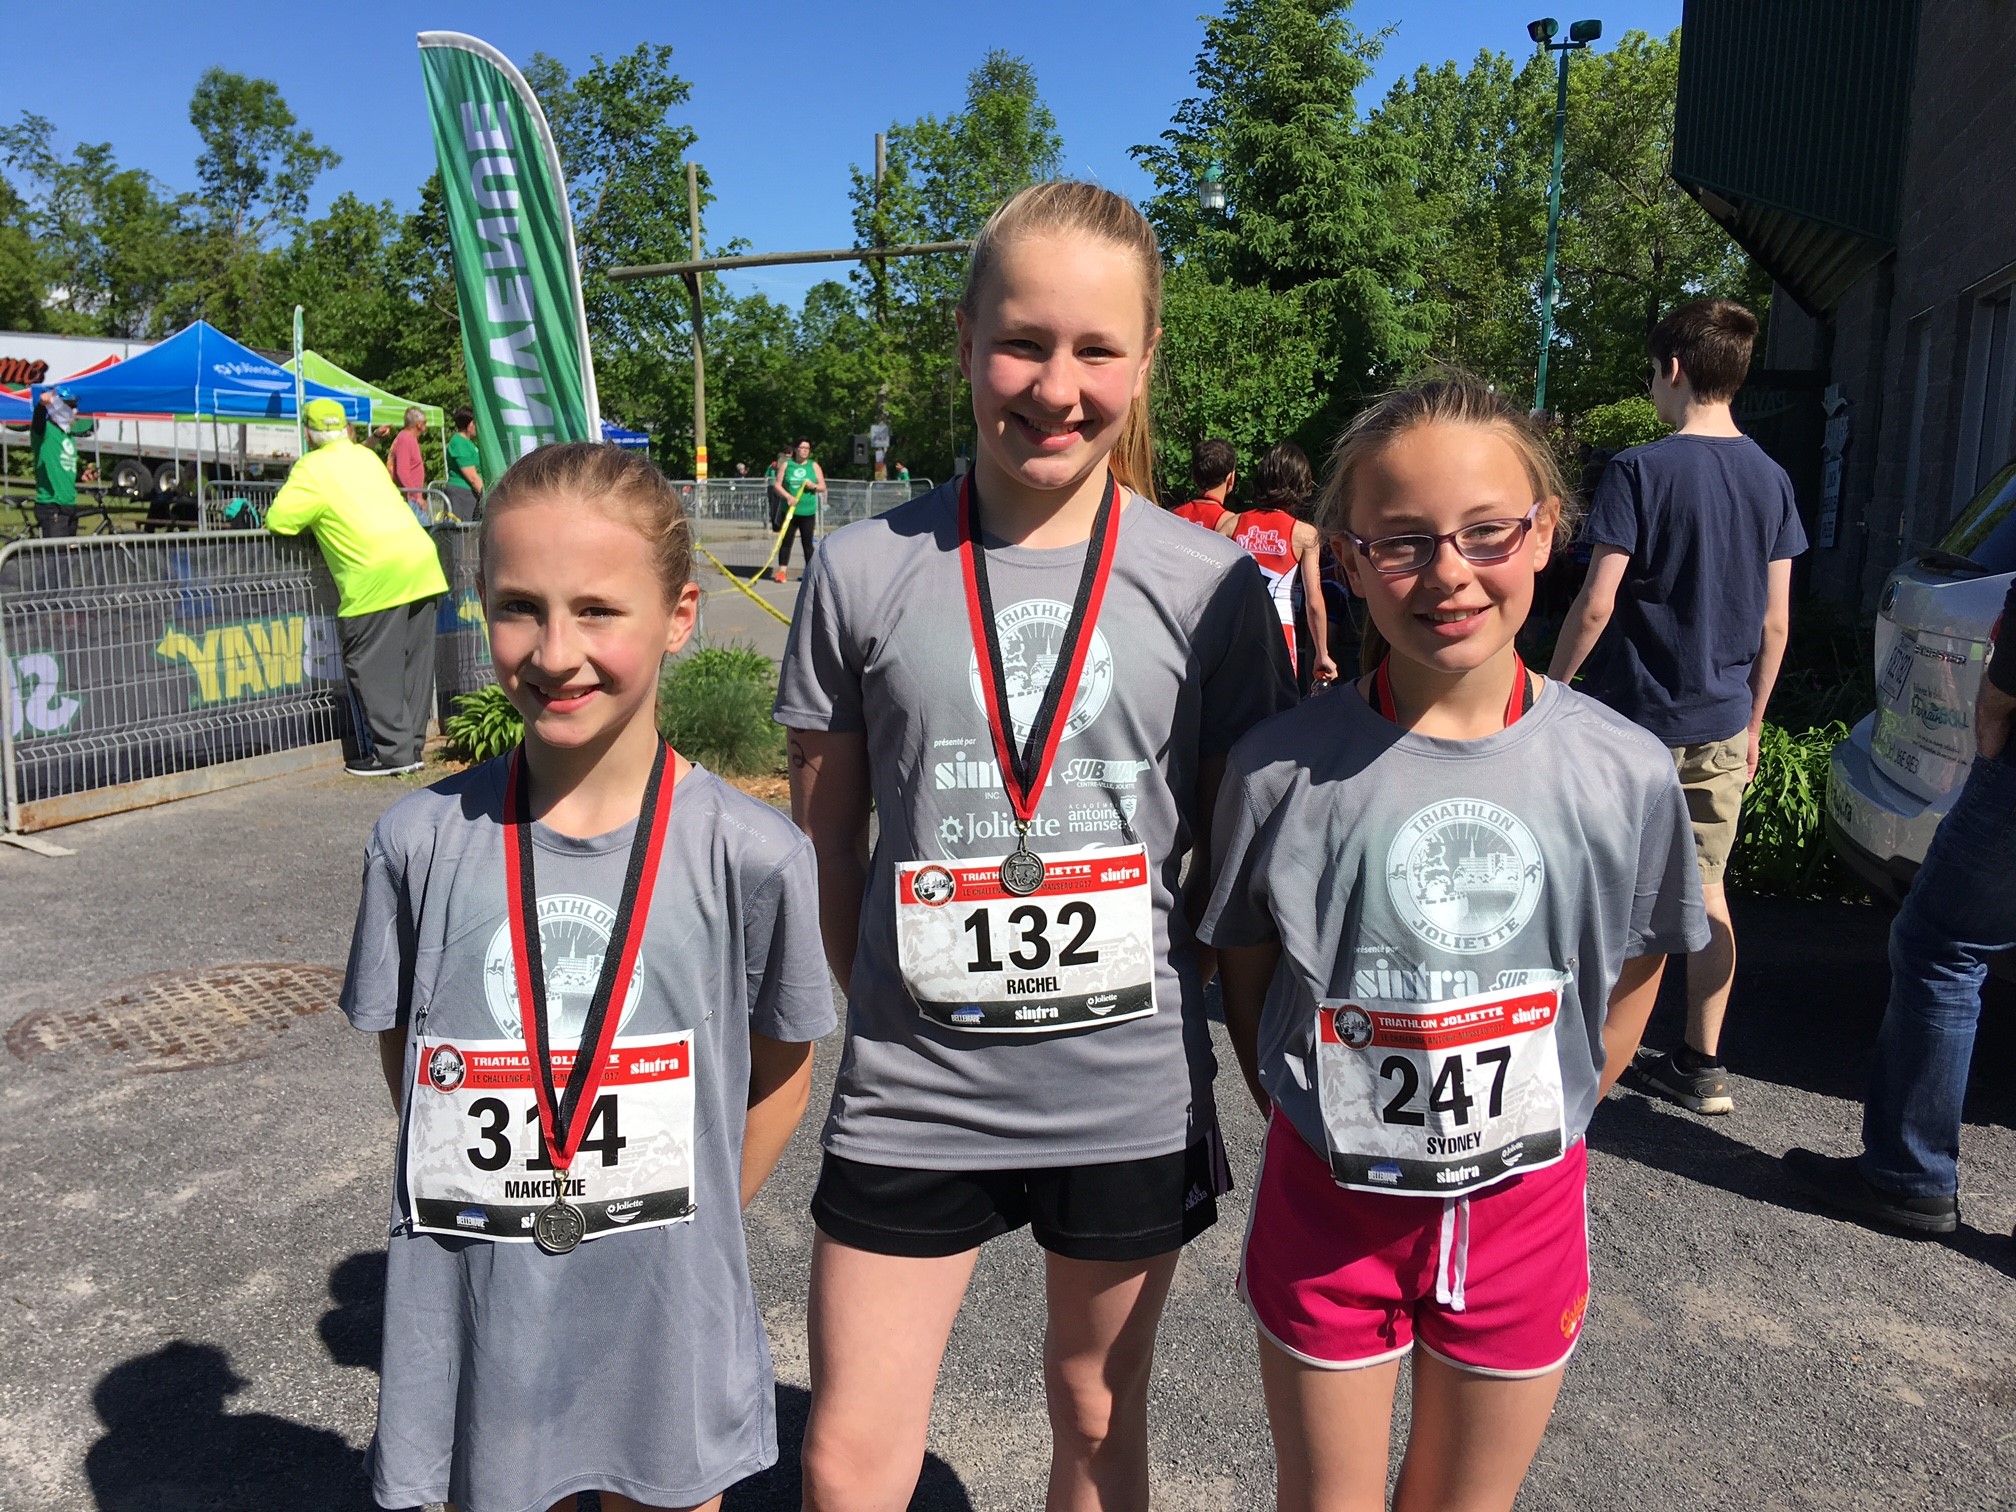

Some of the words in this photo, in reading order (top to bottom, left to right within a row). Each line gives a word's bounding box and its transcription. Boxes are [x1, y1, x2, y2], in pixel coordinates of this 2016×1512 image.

[964, 738, 977, 747] par
[1068, 808, 1121, 820] antoine
[1410, 803, 1515, 835] TRIATHLON
[1069, 819, 1123, 832] mansea
[962, 871, 1000, 882] TRIATH
[1100, 867, 1141, 883] sintra
[964, 901, 1099, 973] 132
[1412, 917, 1520, 949] JOLIETTE
[1006, 976, 1061, 995] RACHEL
[1354, 958, 1480, 1001] sintra
[1094, 994, 1118, 1005] Joliette
[1014, 1005, 1059, 1021] sintra
[1378, 1017, 1437, 1029] TRIATHLON
[1440, 1006, 1504, 1027] JOLIETTE
[1511, 1006, 1551, 1025] sintra
[473, 1056, 530, 1067] TRIATHLO
[629, 1057, 680, 1075] sintra
[473, 1075, 481, 1083] LE
[482, 1074, 524, 1083] CHALLENGE
[604, 1071, 619, 1081] 017
[1379, 1045, 1512, 1127] 247
[466, 1094, 627, 1172] 314
[1426, 1131, 1482, 1155] SYDNEY
[1436, 1165, 1480, 1183] sintra
[504, 1178, 587, 1199] MAKENZIE
[615, 1199, 645, 1213] Joliette
